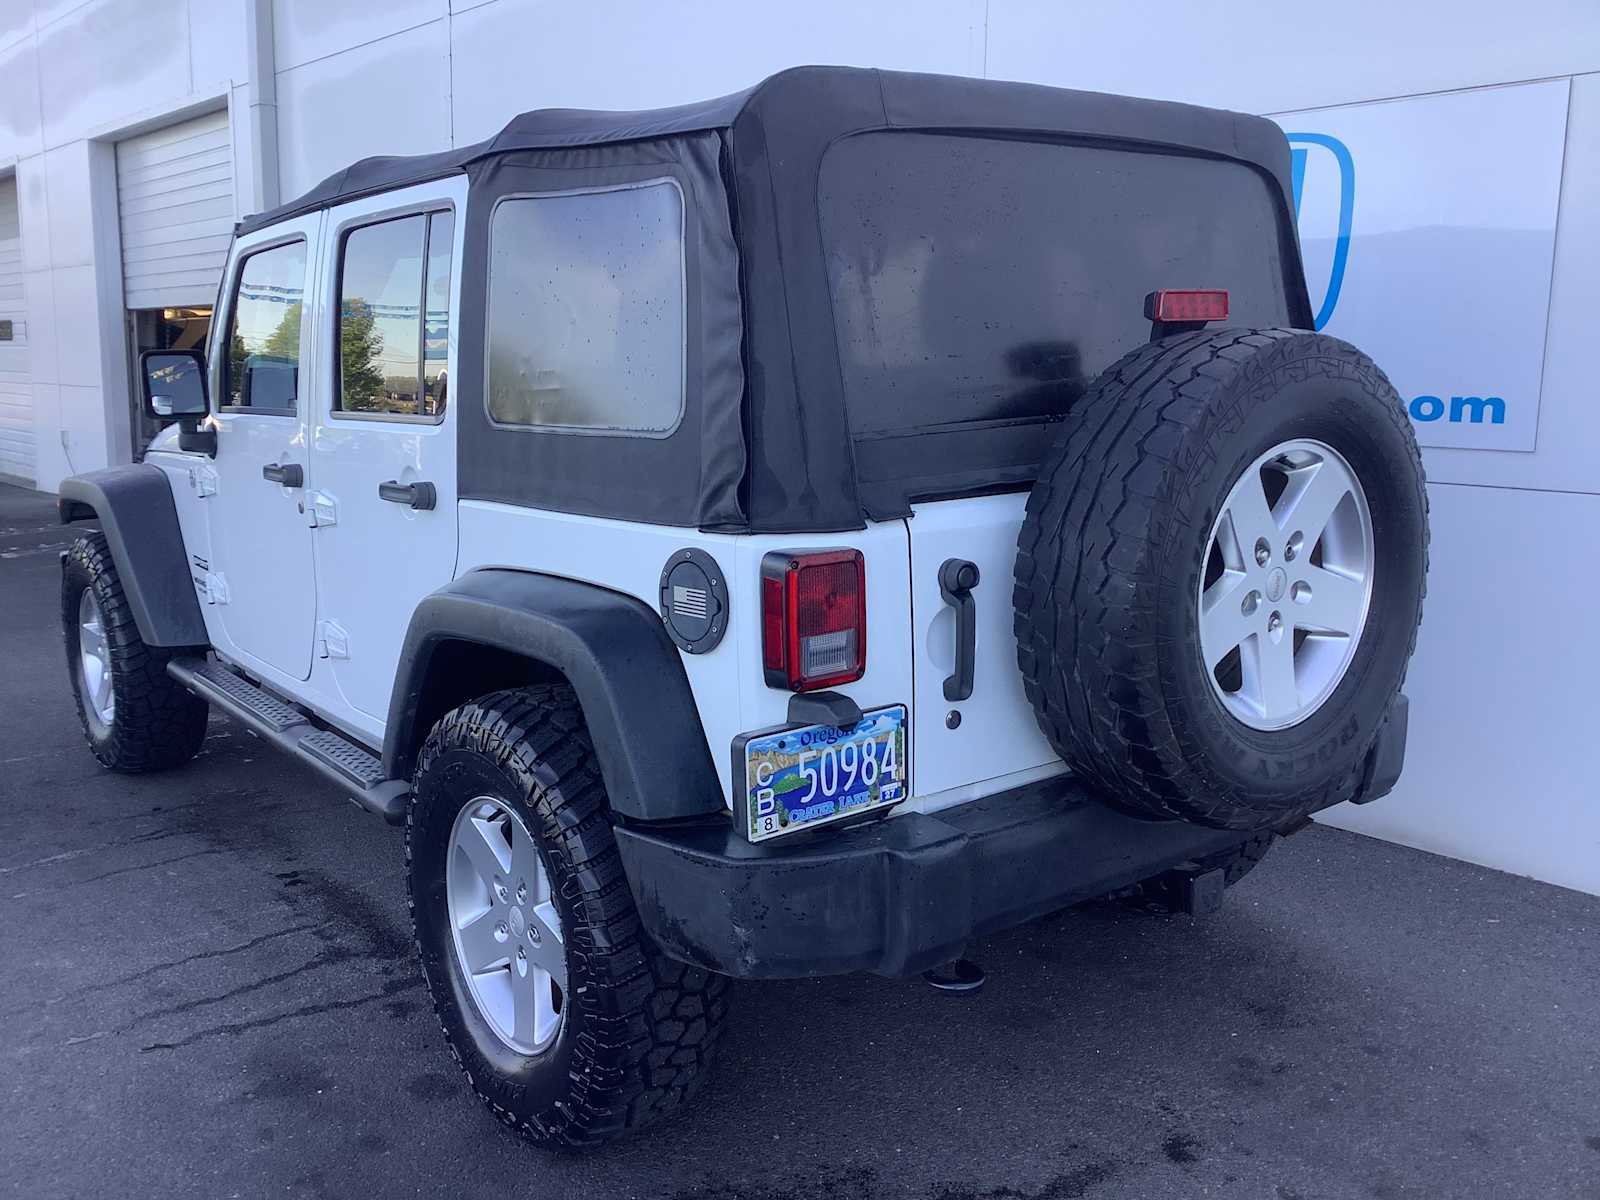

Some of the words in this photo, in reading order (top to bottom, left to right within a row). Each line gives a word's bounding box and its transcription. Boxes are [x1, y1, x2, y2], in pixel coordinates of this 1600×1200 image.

[800, 731, 897, 803] 50984
[789, 801, 835, 822] CRATER
[838, 791, 871, 810] LAKE
[764, 817, 773, 831] 8
